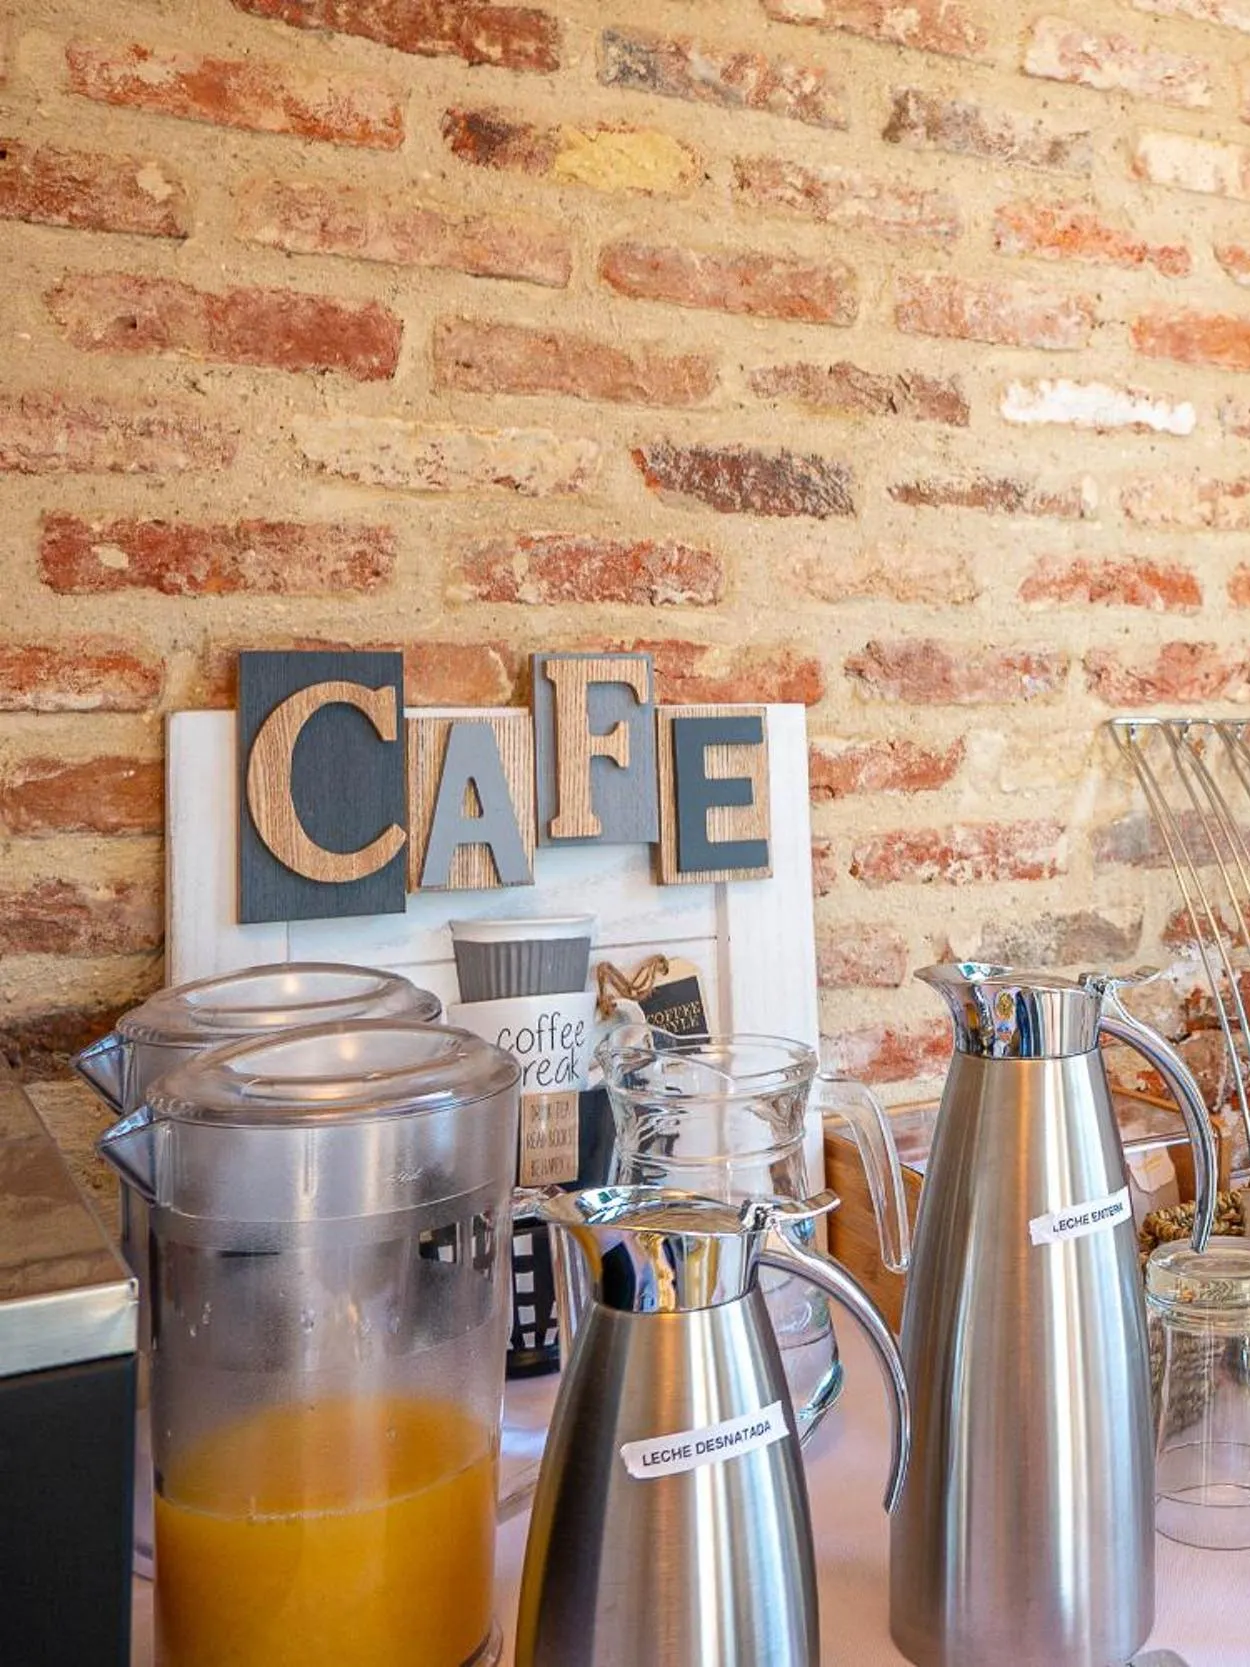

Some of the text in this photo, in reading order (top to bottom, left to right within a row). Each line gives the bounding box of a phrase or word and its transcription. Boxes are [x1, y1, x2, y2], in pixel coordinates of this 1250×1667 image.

[246, 658, 769, 885] CAFE
[497, 1012, 584, 1054] coffee
[522, 1047, 579, 1087] reak
[1053, 1212, 1089, 1233] LECHE
[642, 1420, 772, 1466] LECHE DESNATADA
